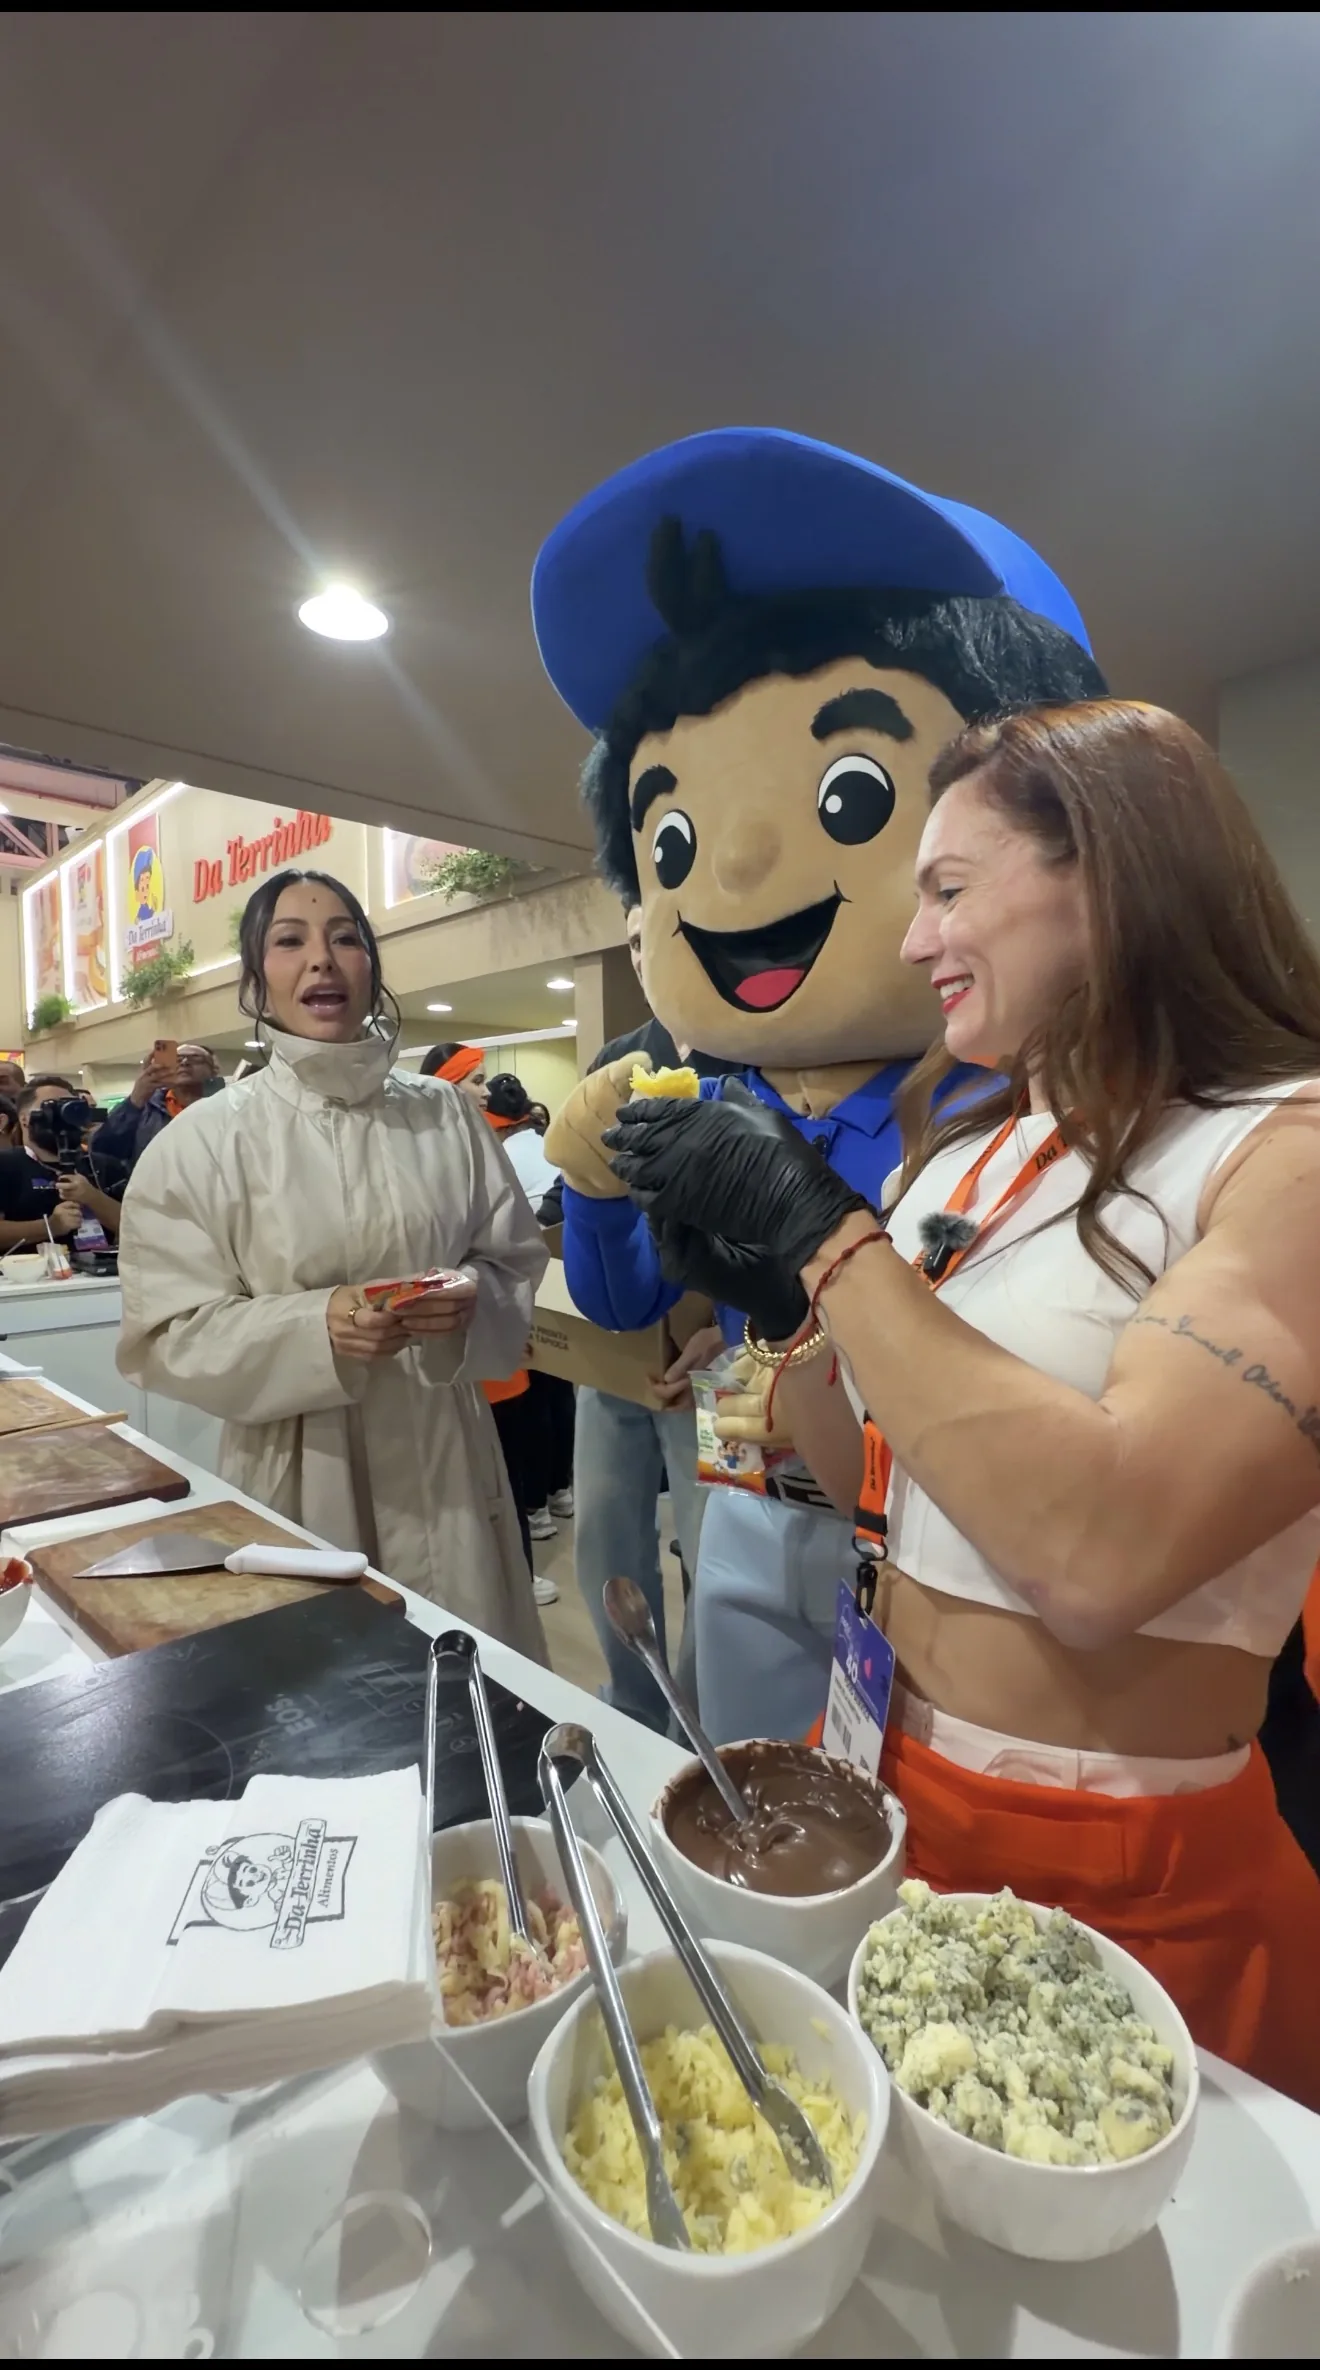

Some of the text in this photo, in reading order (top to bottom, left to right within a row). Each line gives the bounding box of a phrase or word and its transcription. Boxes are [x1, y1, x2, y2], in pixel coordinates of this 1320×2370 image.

[193, 809, 332, 903] Da Terrinha
[1035, 1144, 1058, 1170] Da
[264, 1697, 317, 1736] EOS
[283, 1827, 323, 1931] Da Terrinha
[316, 1847, 340, 1909] Alimentos
